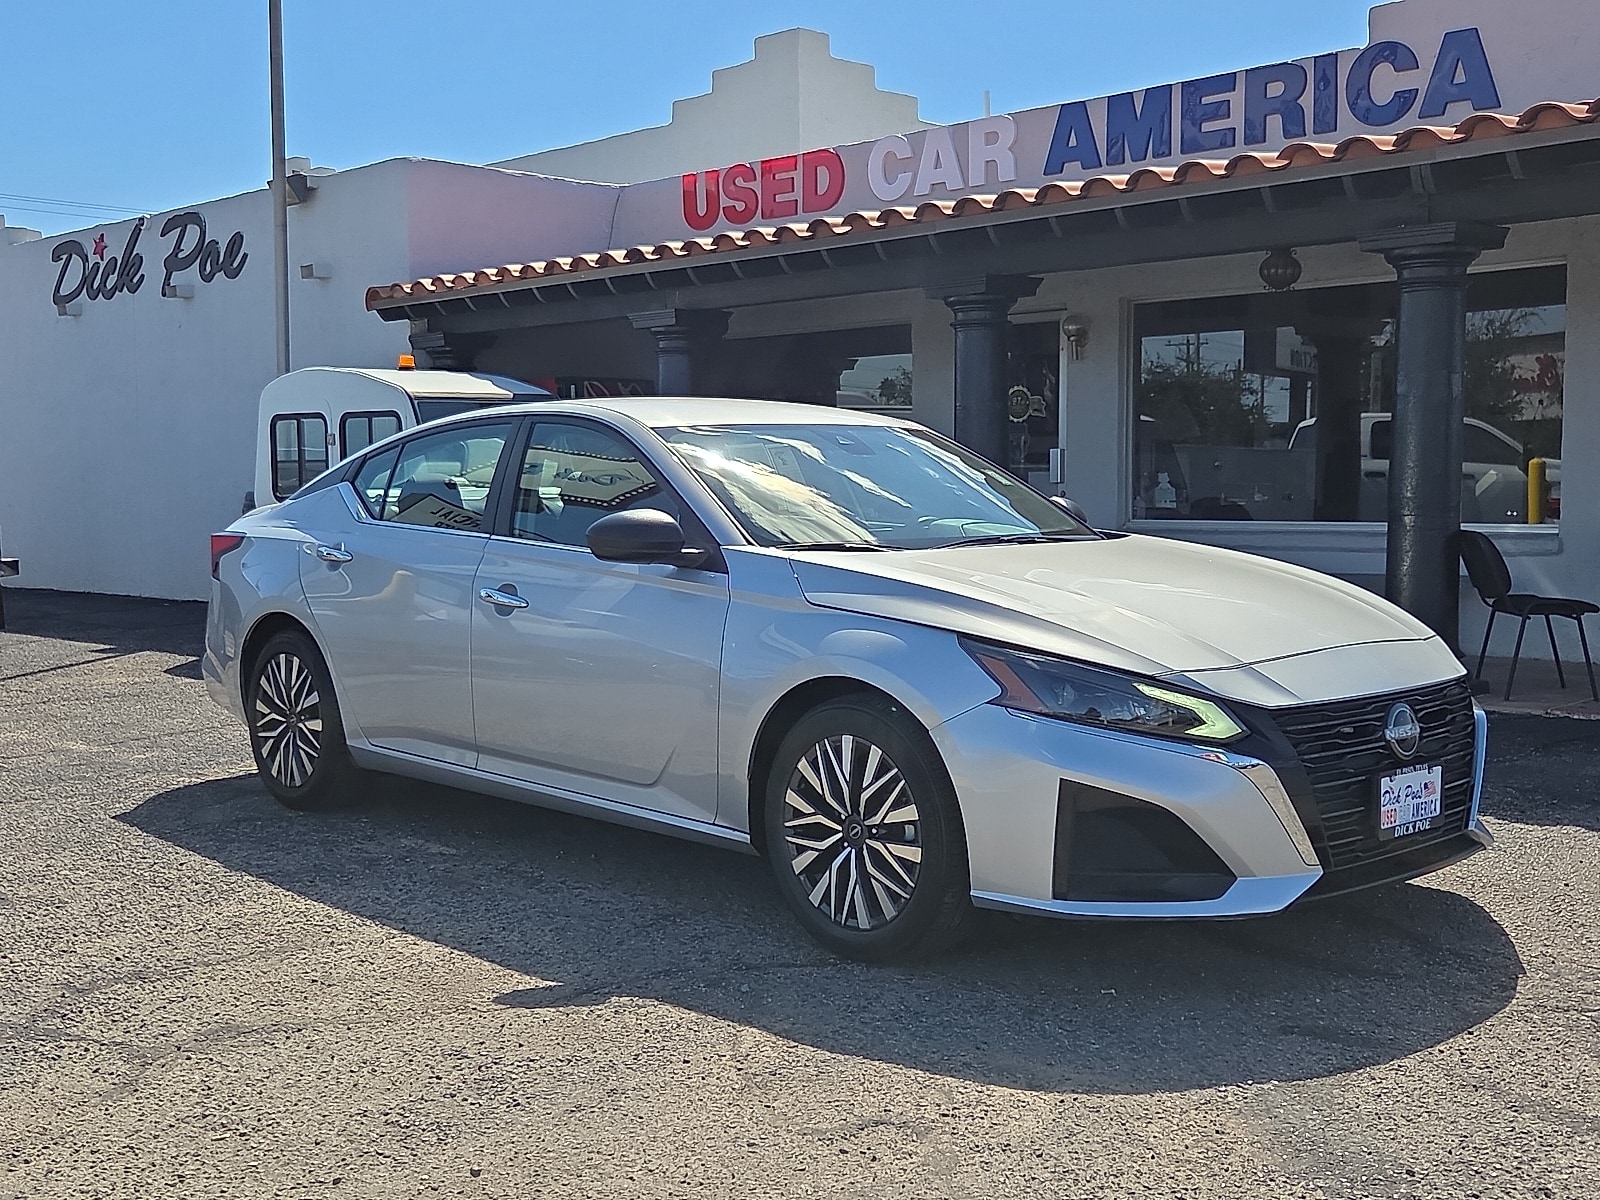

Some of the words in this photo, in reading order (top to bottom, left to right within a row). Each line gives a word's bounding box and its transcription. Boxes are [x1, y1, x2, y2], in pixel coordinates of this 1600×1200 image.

[681, 147, 847, 232] USED
[867, 114, 1018, 202] CAR
[1044, 27, 1502, 177] AMERICA
[51, 216, 146, 306] Dick
[160, 211, 249, 298] Poe
[1382, 786, 1402, 808] Dick
[1381, 807, 1398, 827] USED
[1410, 798, 1439, 820] AMERICA
[1394, 822, 1415, 838] DICK
[1414, 818, 1432, 832] POE
